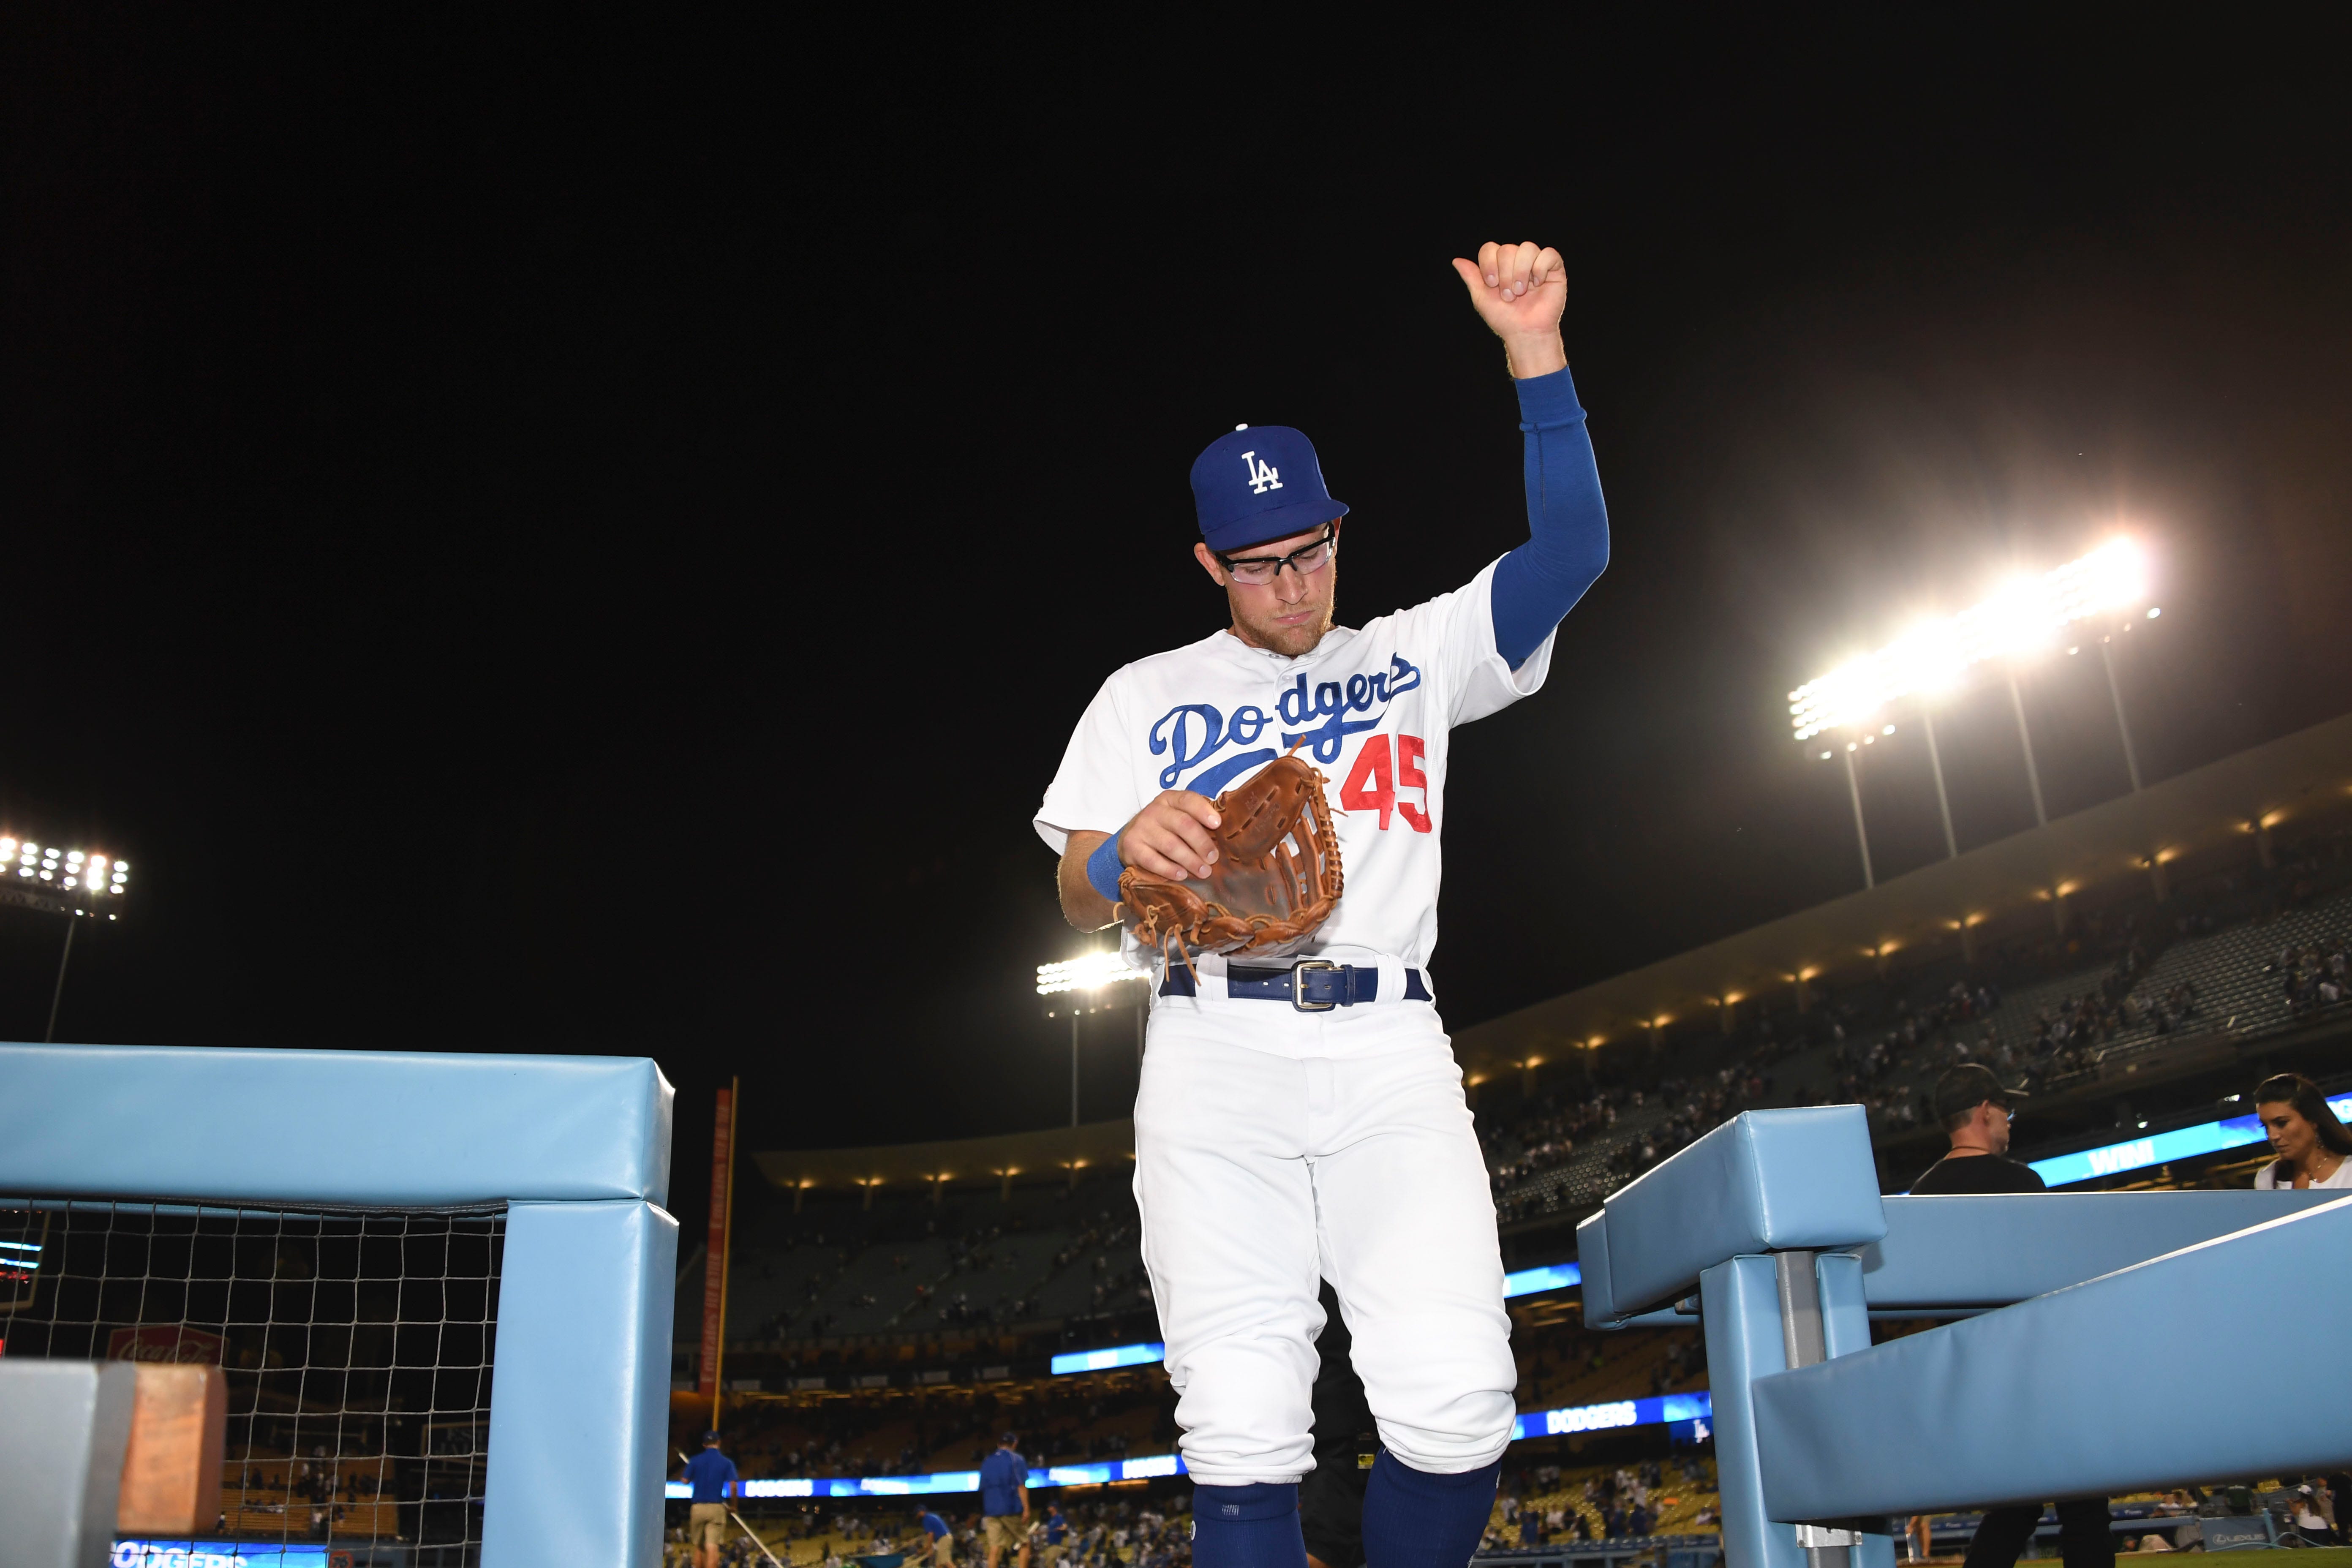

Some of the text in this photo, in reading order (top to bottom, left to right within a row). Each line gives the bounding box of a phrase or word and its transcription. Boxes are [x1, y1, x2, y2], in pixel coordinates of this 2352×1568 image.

[1241, 451, 1283, 494] LA
[1149, 652, 1421, 790] Dodgers
[1340, 733, 1432, 833] 45
[2088, 1140, 2154, 1175] WIN!
[1547, 1399, 1637, 1435] DODGERS
[109, 1542, 247, 1568] ODGERS
